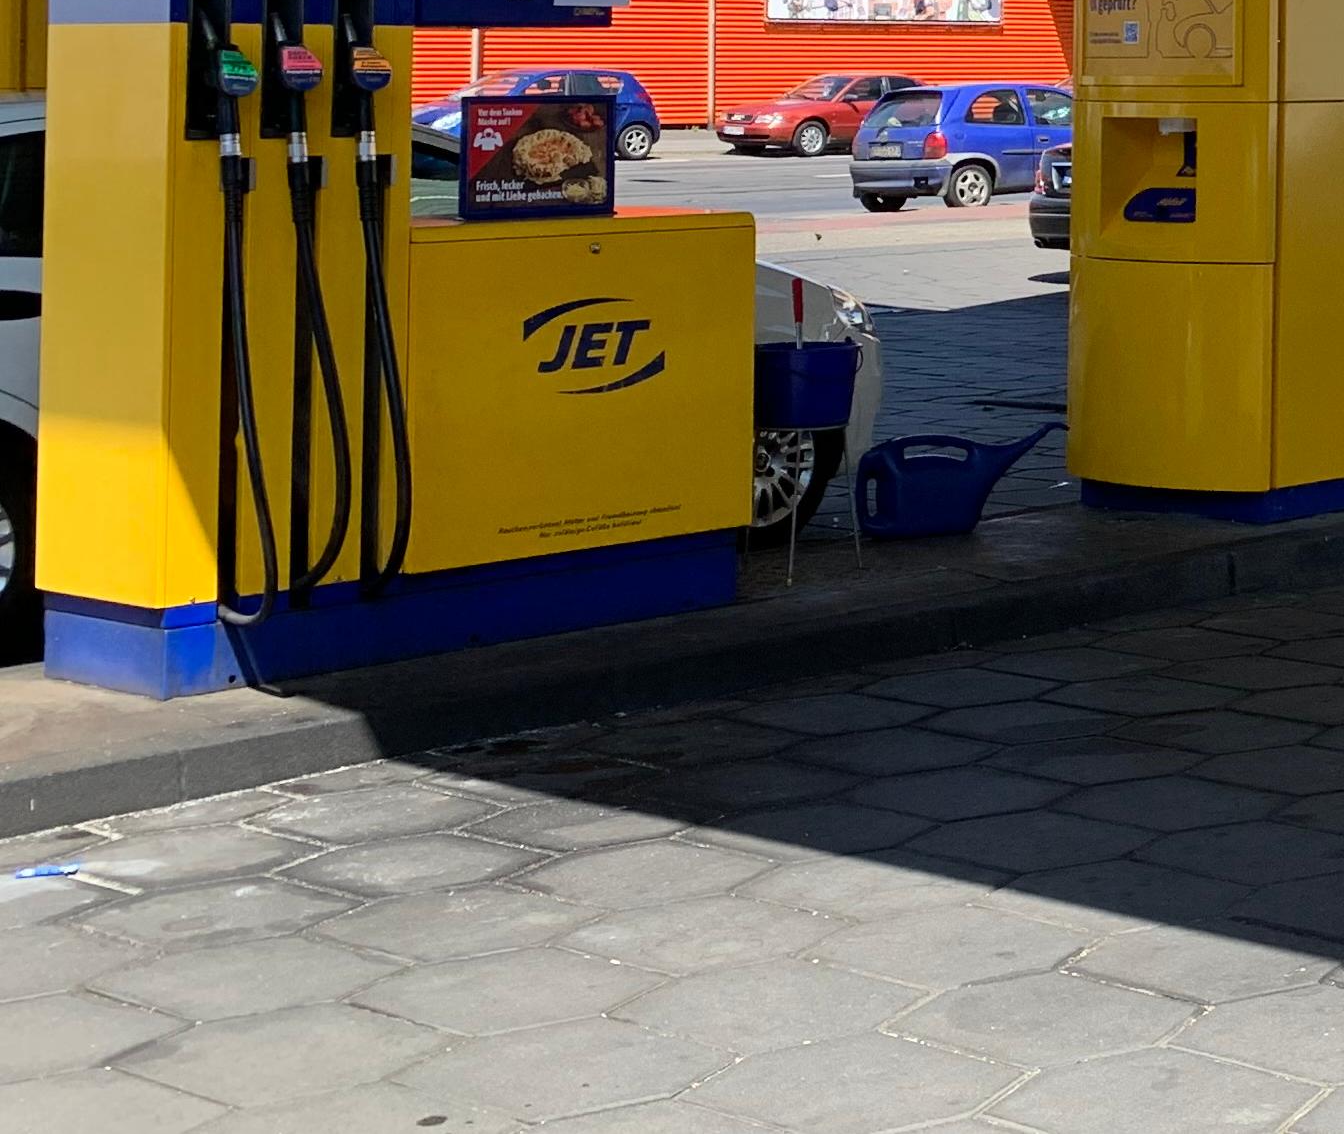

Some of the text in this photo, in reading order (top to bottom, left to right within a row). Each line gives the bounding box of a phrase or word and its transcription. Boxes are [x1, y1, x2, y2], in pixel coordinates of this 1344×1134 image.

[476, 179, 525, 192] Frisch, lecker
[476, 190, 564, 203] und mit Liebe gebacken.
[538, 319, 652, 373] JET
